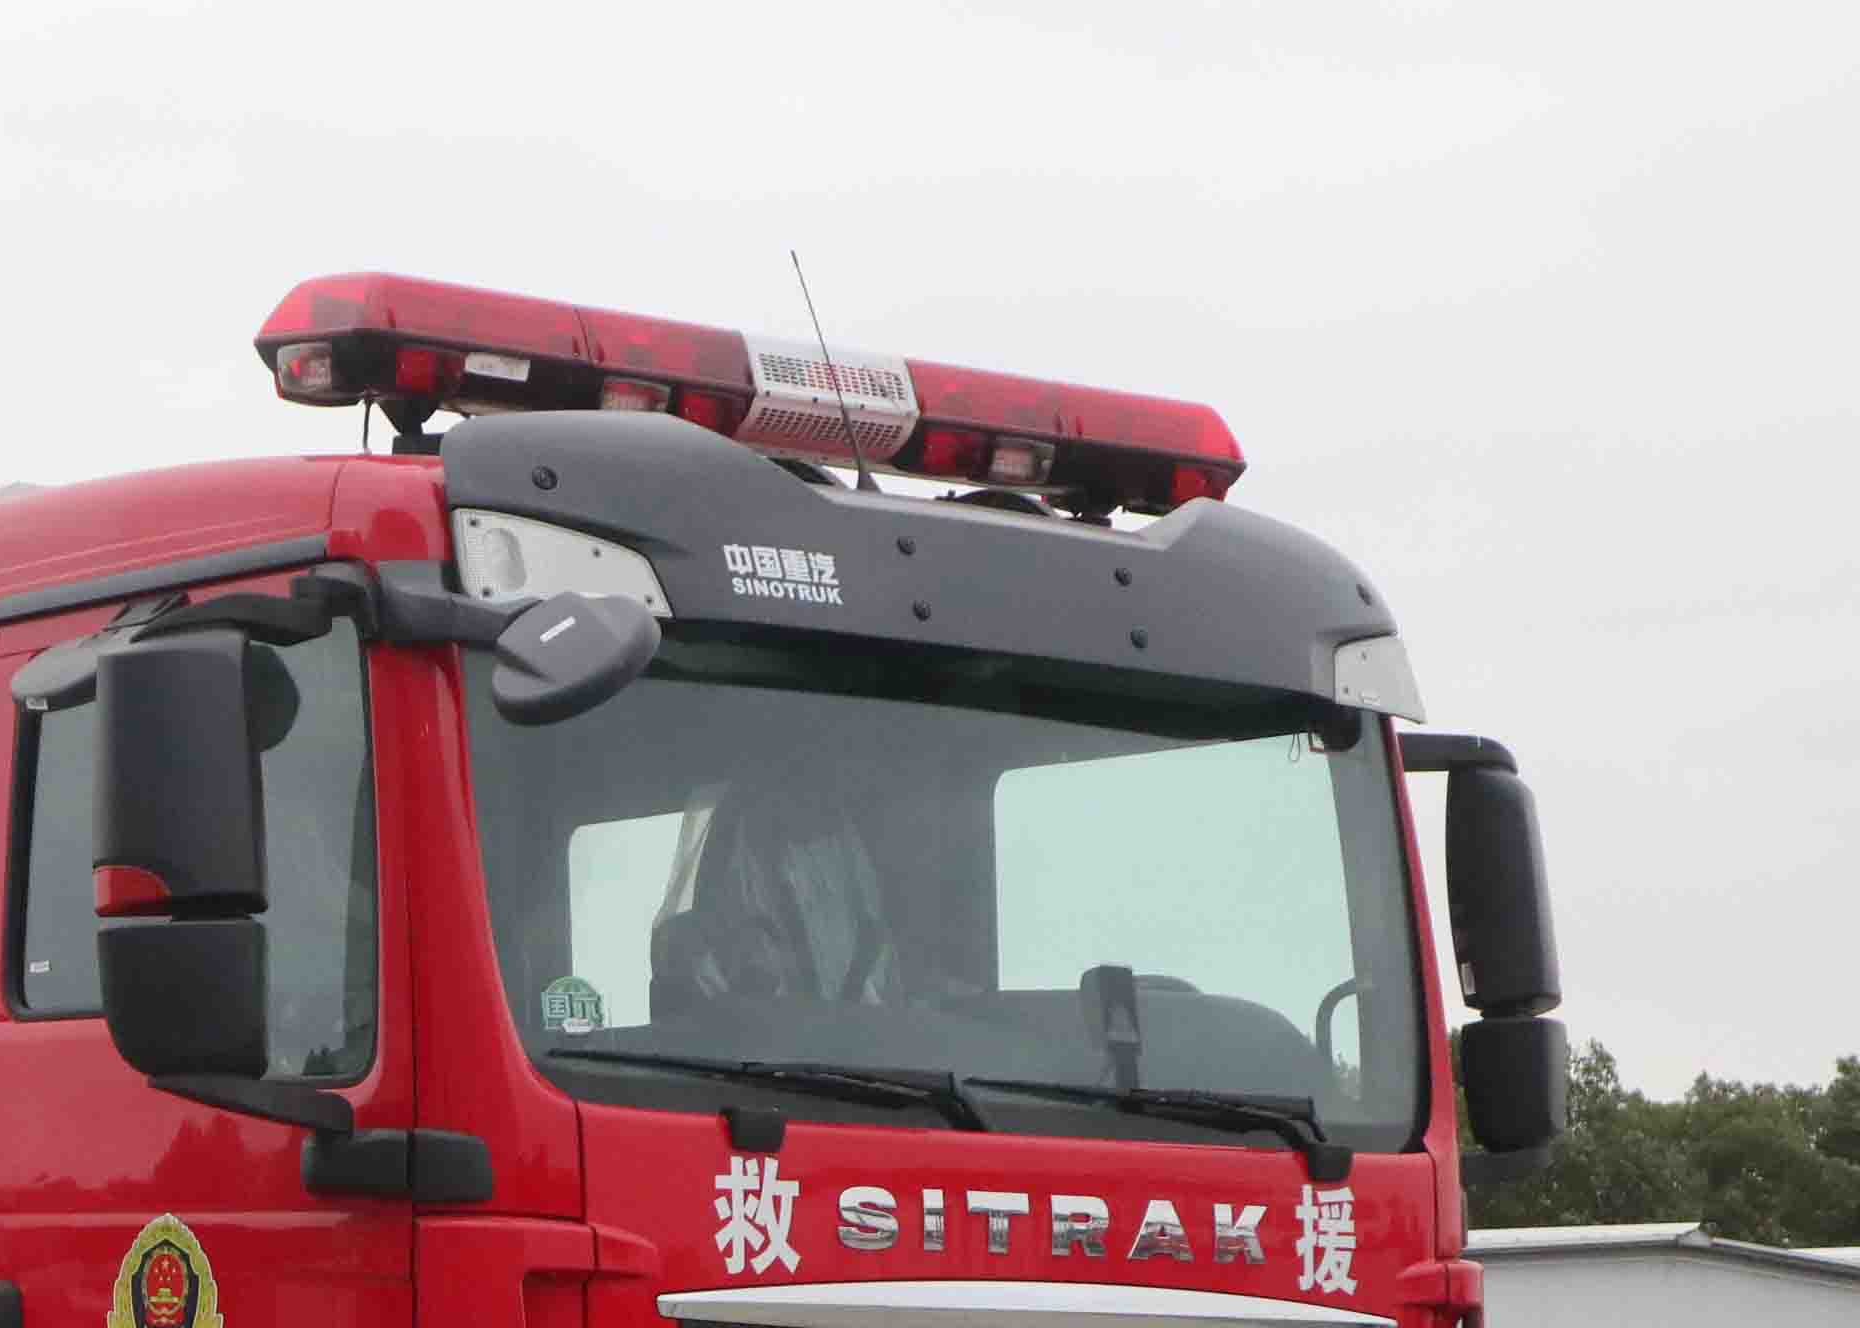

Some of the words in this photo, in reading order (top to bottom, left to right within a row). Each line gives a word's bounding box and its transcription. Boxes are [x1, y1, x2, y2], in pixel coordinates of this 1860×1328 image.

[723, 543, 840, 585] 中国重汽
[731, 576, 844, 605] SINOTRUK
[714, 1155, 802, 1275] 救
[837, 1186, 1268, 1265] SITRAK
[1295, 1184, 1357, 1296] 援
